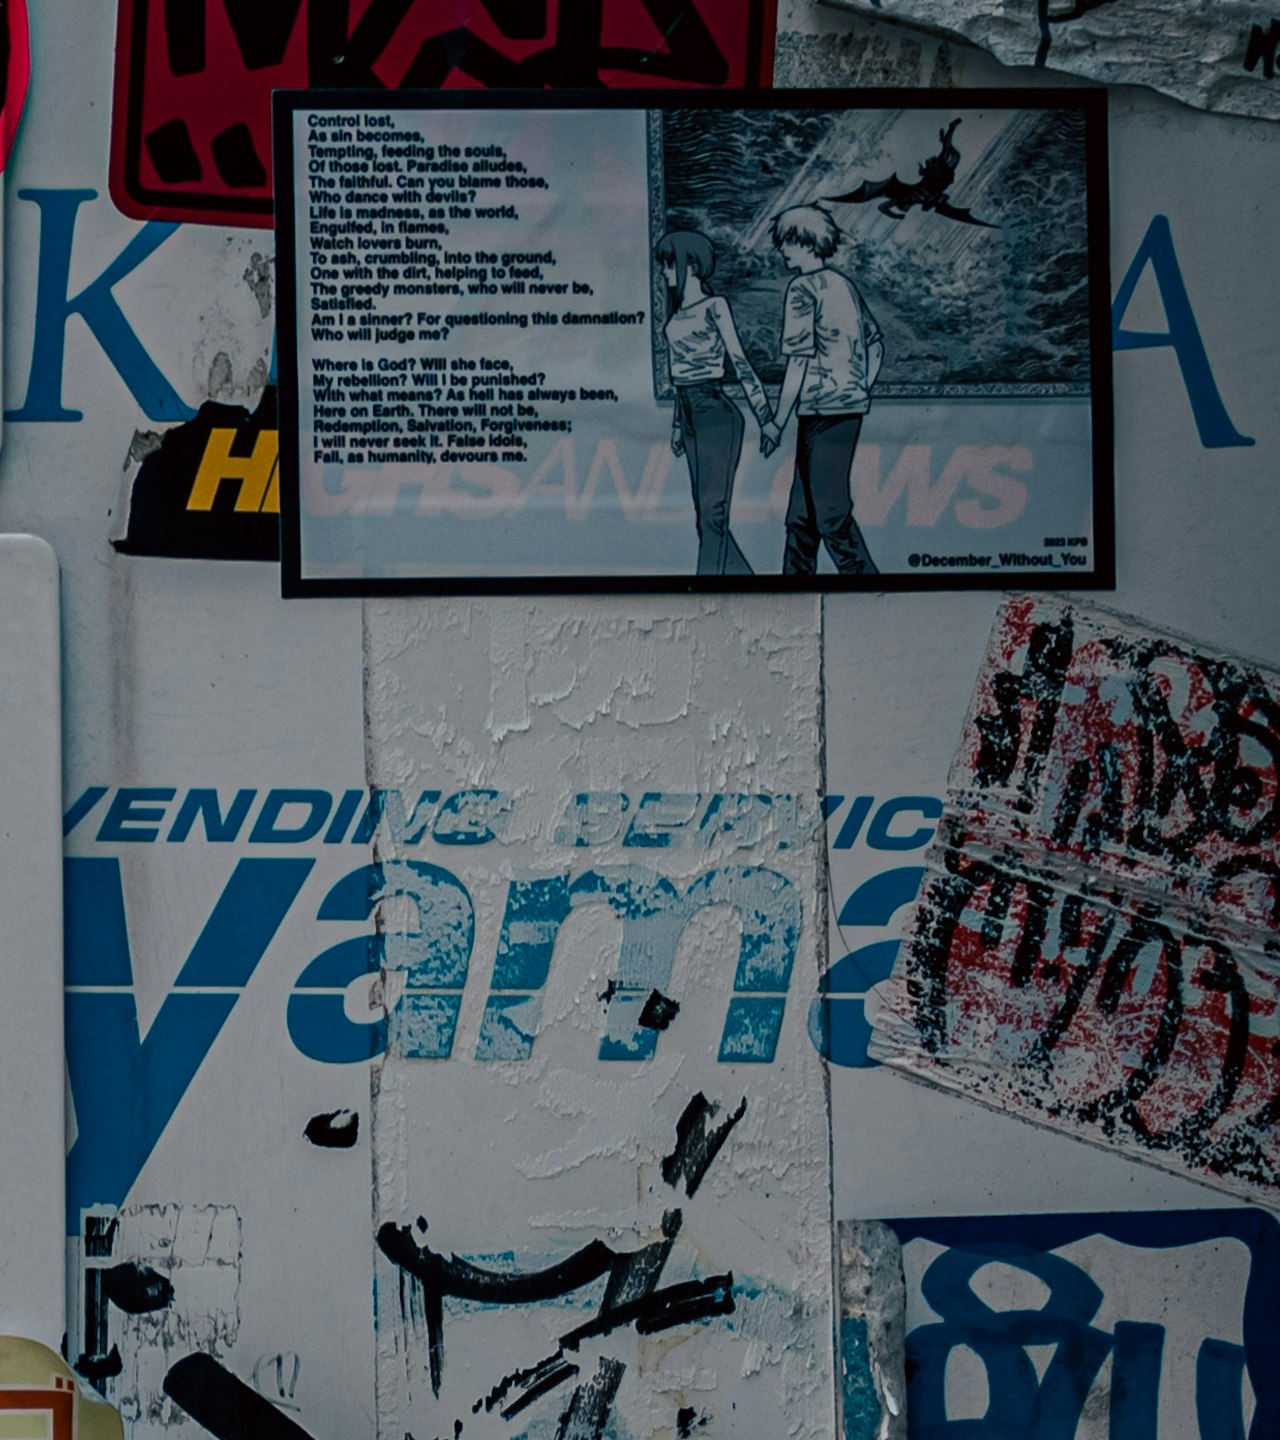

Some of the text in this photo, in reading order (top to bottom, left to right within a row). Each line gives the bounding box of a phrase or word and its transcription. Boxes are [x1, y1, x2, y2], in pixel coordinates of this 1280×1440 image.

[307, 114, 396, 128] Control lost,
[307, 129, 426, 143] As sin becomes,
[307, 143, 508, 160] Tempting, feeding the souls,
[308, 158, 528, 173] Of those lost. Paradise alludes,
[308, 174, 550, 190] The faithful. Can you blame those,
[308, 189, 477, 203] Who dance with devils?
[309, 205, 520, 220] Life is madness, as the world,
[309, 220, 451, 237] Engulfed, in flames,
[309, 236, 443, 250] Watch lovers burn,
[309, 250, 558, 267] To ash, crumbling, into the ground,
[310, 265, 544, 281] One with the dirt, helping to feed,
[309, 280, 595, 298] The greedy monsters, who will never be,
[310, 297, 377, 310] Satisfied.
[311, 312, 335, 325] Am
[359, 312, 414, 325] sinner?
[416, 312, 442, 324] For
[444, 311, 529, 327] questioning
[530, 311, 560, 324] this
[560, 310, 646, 323] damnation?
[310, 327, 450, 343] Who will judge me?
[311, 357, 514, 372] Where is God? Will she face,
[312, 373, 333, 389] My
[337, 373, 408, 386] rebellion?
[411, 373, 438, 385] Will
[450, 372, 468, 385] be
[471, 372, 547, 388] punished?
[312, 386, 619, 403] With what means? As hell has always been,
[313, 402, 539, 417] Here on Earth. There will not be,
[313, 418, 573, 435] Redemption, Salvation, Forgiveness;
[320, 435, 346, 447] will
[349, 437, 390, 447] never
[393, 434, 426, 447] seek
[430, 434, 443, 447] it.
[447, 434, 486, 446] False
[488, 433, 529, 448] idols,
[313, 449, 528, 466] Fall, as humanity, devours me.
[907, 551, 1086, 567] @December_Without_You
